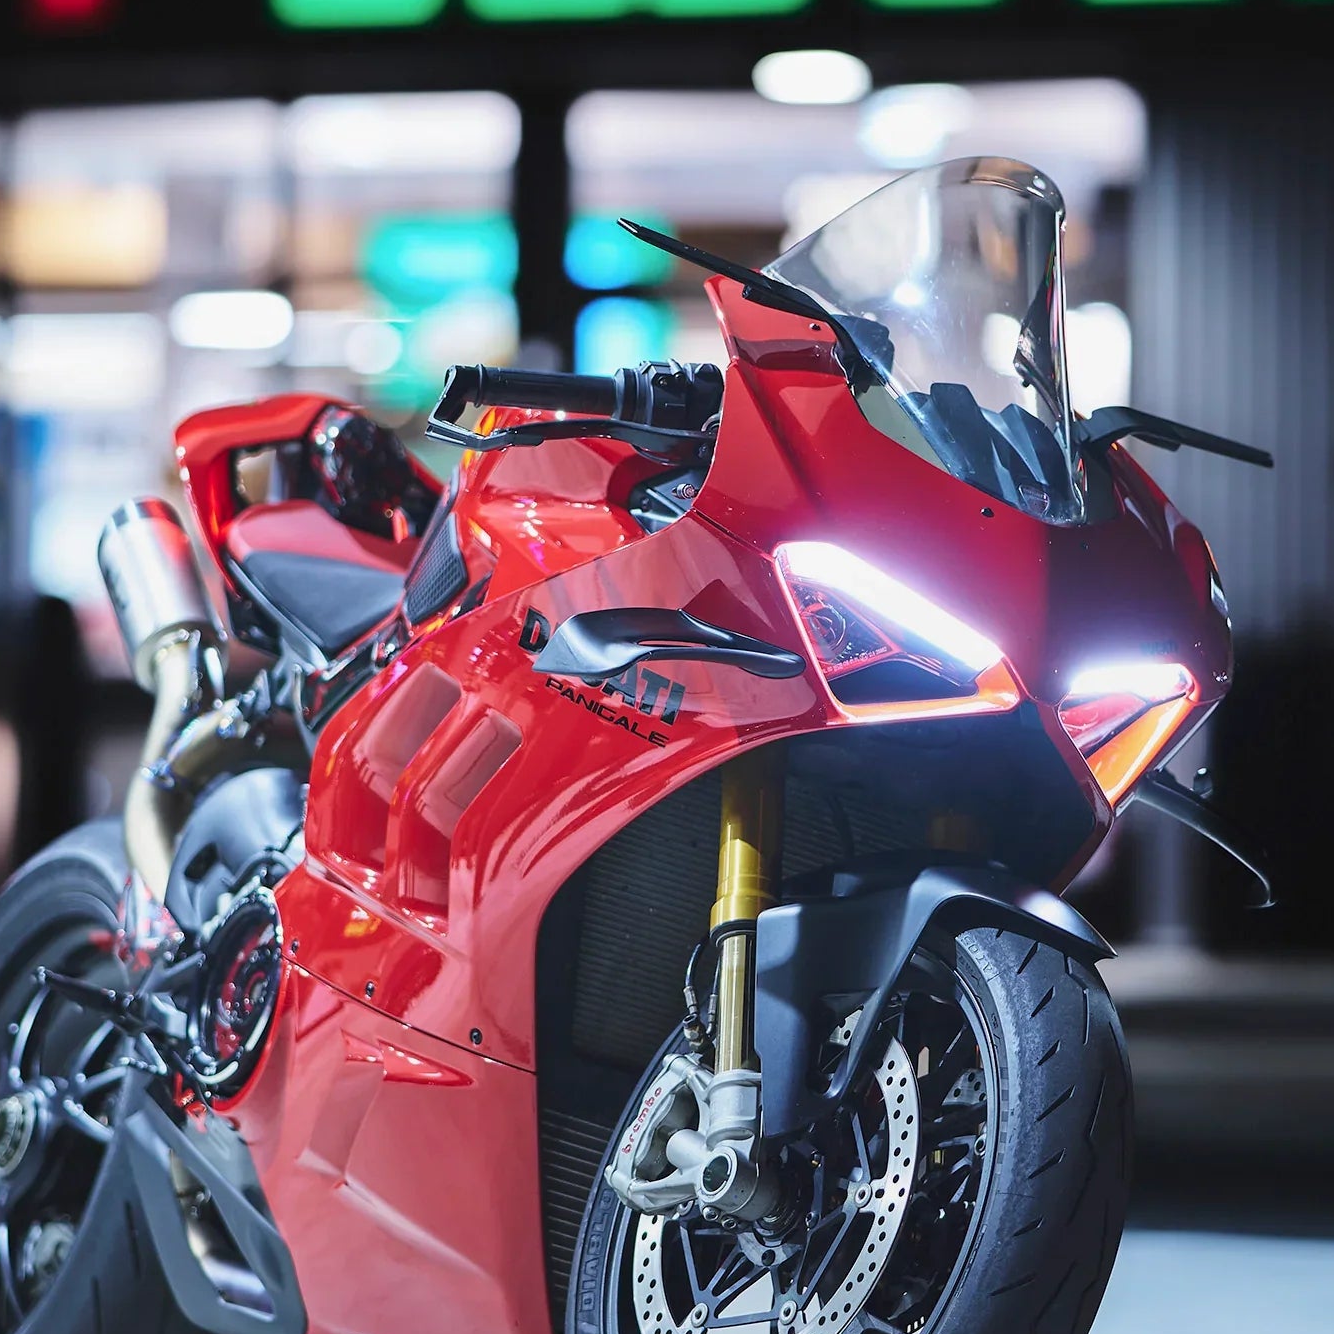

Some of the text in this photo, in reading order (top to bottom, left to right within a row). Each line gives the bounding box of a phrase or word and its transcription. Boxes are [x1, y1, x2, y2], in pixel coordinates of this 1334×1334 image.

[519, 607, 686, 726] DATI
[546, 677, 670, 748] PANIGALE
[621, 1087, 662, 1154] brembo
[578, 1188, 617, 1314] DIABLO
